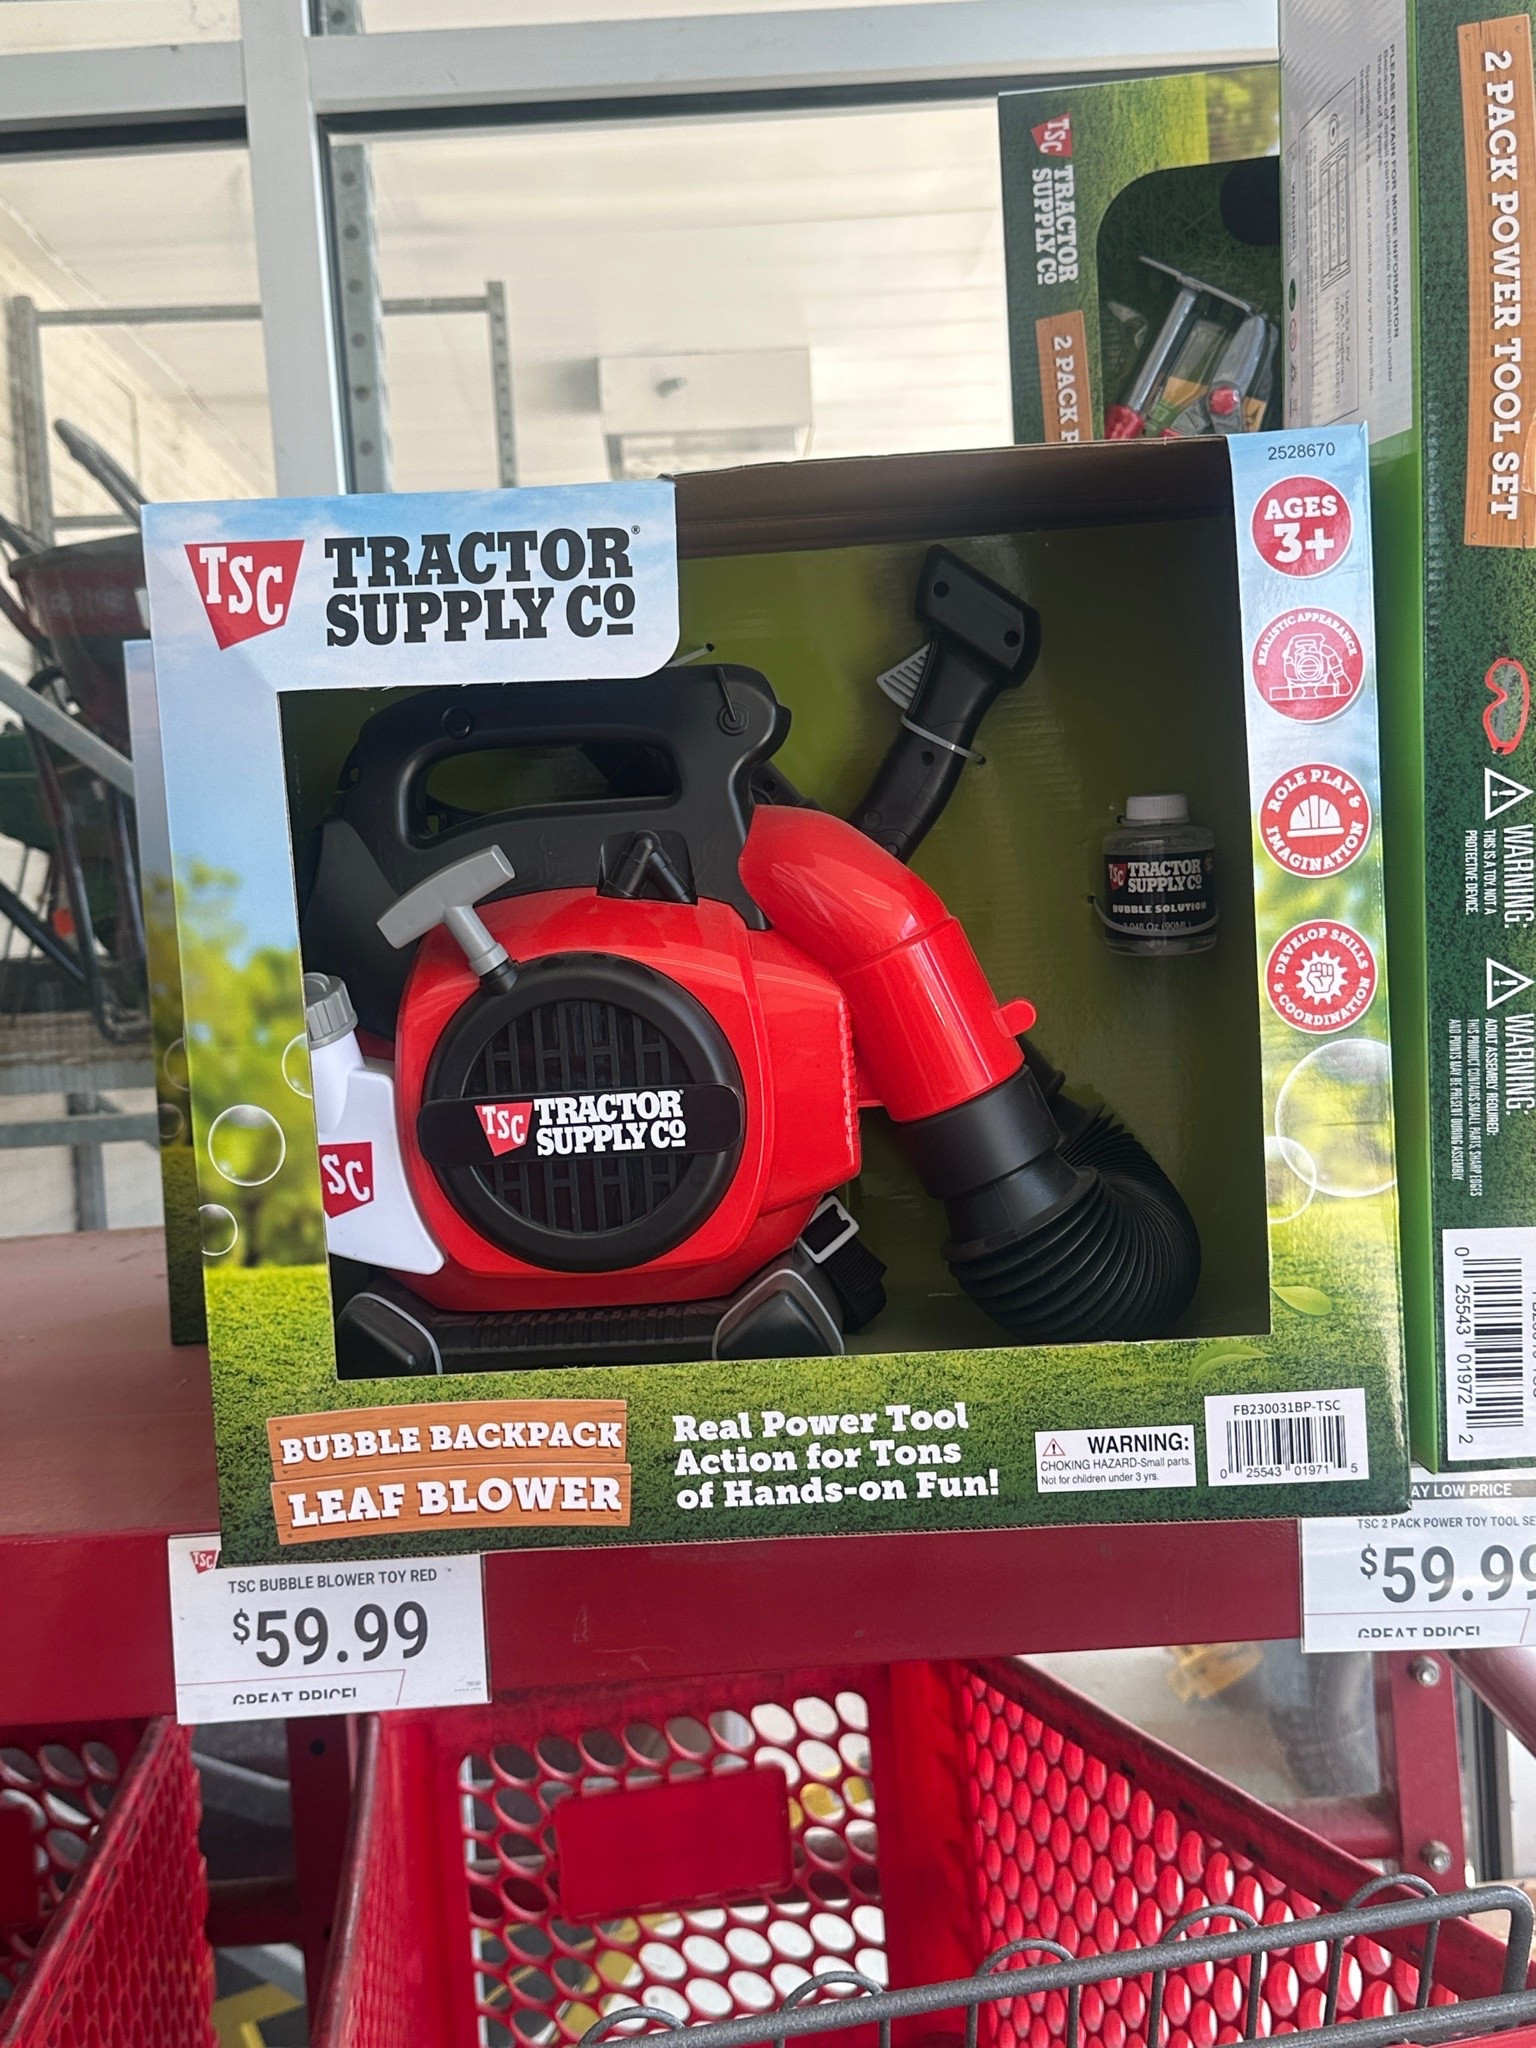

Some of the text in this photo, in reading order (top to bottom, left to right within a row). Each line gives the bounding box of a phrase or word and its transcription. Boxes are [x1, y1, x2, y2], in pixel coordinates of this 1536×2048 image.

[1040, 117, 1070, 154] TSC
[1032, 169, 1055, 255] SUPPLY
[1053, 166, 1077, 282] TRACTOR
[1484, 50, 1522, 519] 2 PACK POWER TOOL SET
[1053, 336, 1072, 350] 2
[1056, 357, 1079, 424] PACK
[1268, 442, 1335, 460] 2528670
[1264, 495, 1338, 520] AGES
[325, 528, 633, 589] TRACTOR
[1274, 523, 1334, 563] 3+
[199, 546, 285, 626] TSC
[326, 586, 555, 647] SUPPLY
[1257, 612, 1358, 666] REALISTIC APPEARANCE
[1267, 769, 1362, 813] ROLE PLAY &
[1266, 821, 1365, 871] IMAGINATION
[1484, 829, 1496, 848] THIS
[1484, 851, 1496, 859] IS
[1109, 864, 1124, 886] TSC
[1128, 859, 1201, 877] TRACTOR
[1128, 876, 1187, 893] SUPPLY
[1465, 830, 1479, 915] PROTECTIVE DEVICE.
[1503, 824, 1534, 928] WARNING:
[1113, 902, 1206, 914] BUBBLE SOLUTION
[1484, 888, 1496, 906] NOT
[1274, 927, 1369, 975] DEVELOP SKILLS
[1273, 976, 1371, 1026] & COORDINATION
[1449, 1019, 1461, 1033] AND
[1449, 1036, 1461, 1059] POINTS
[1505, 1013, 1535, 1115] WARNING:
[1450, 1061, 1462, 1075] MAY
[1450, 1078, 1462, 1086] BE
[1485, 1018, 1499, 1136] ADULT ASSEMBLY REQUIRED:
[533, 1090, 684, 1126] TRACTOR
[1450, 1088, 1463, 1116] PRESENT
[1467, 1019, 1482, 1196] THIS PRODUCT CONTAINS SMALL PARTS, SHARP EDGES
[482, 1106, 525, 1144] TSC
[536, 1122, 647, 1156] SUPPLY
[1451, 1118, 1463, 1144] DURING
[321, 1154, 371, 1203] SC
[1455, 1247, 1473, 1444] 0 25543 01972 2
[672, 1402, 969, 1442] Real Power Tool
[1233, 1400, 1341, 1416] FB230031BP-TSC
[279, 1421, 623, 1465] BUBBLE BACKPACK
[674, 1439, 962, 1475] Action for Tons
[1087, 1432, 1190, 1455] WARNING:
[1040, 1457, 1192, 1471] CHOKING HAZARD-Small parts.
[1041, 1472, 1160, 1485] Not for children under 3 yrs.
[1220, 1462, 1358, 1480] 0 25543 01971 5
[287, 1476, 623, 1528] LEAF BLOWER
[676, 1468, 999, 1510] of Hands-on Fun!
[1434, 1484, 1465, 1497] LOW
[1469, 1483, 1512, 1497] PRICE
[1357, 1516, 1536, 1529] TSC 2 PACK POWER TOY TOOL SE
[193, 1551, 213, 1570] TSC
[228, 1568, 437, 1593] TSC BUBBLE BLOWER TOY RED
[232, 1601, 428, 1667] $59.99
